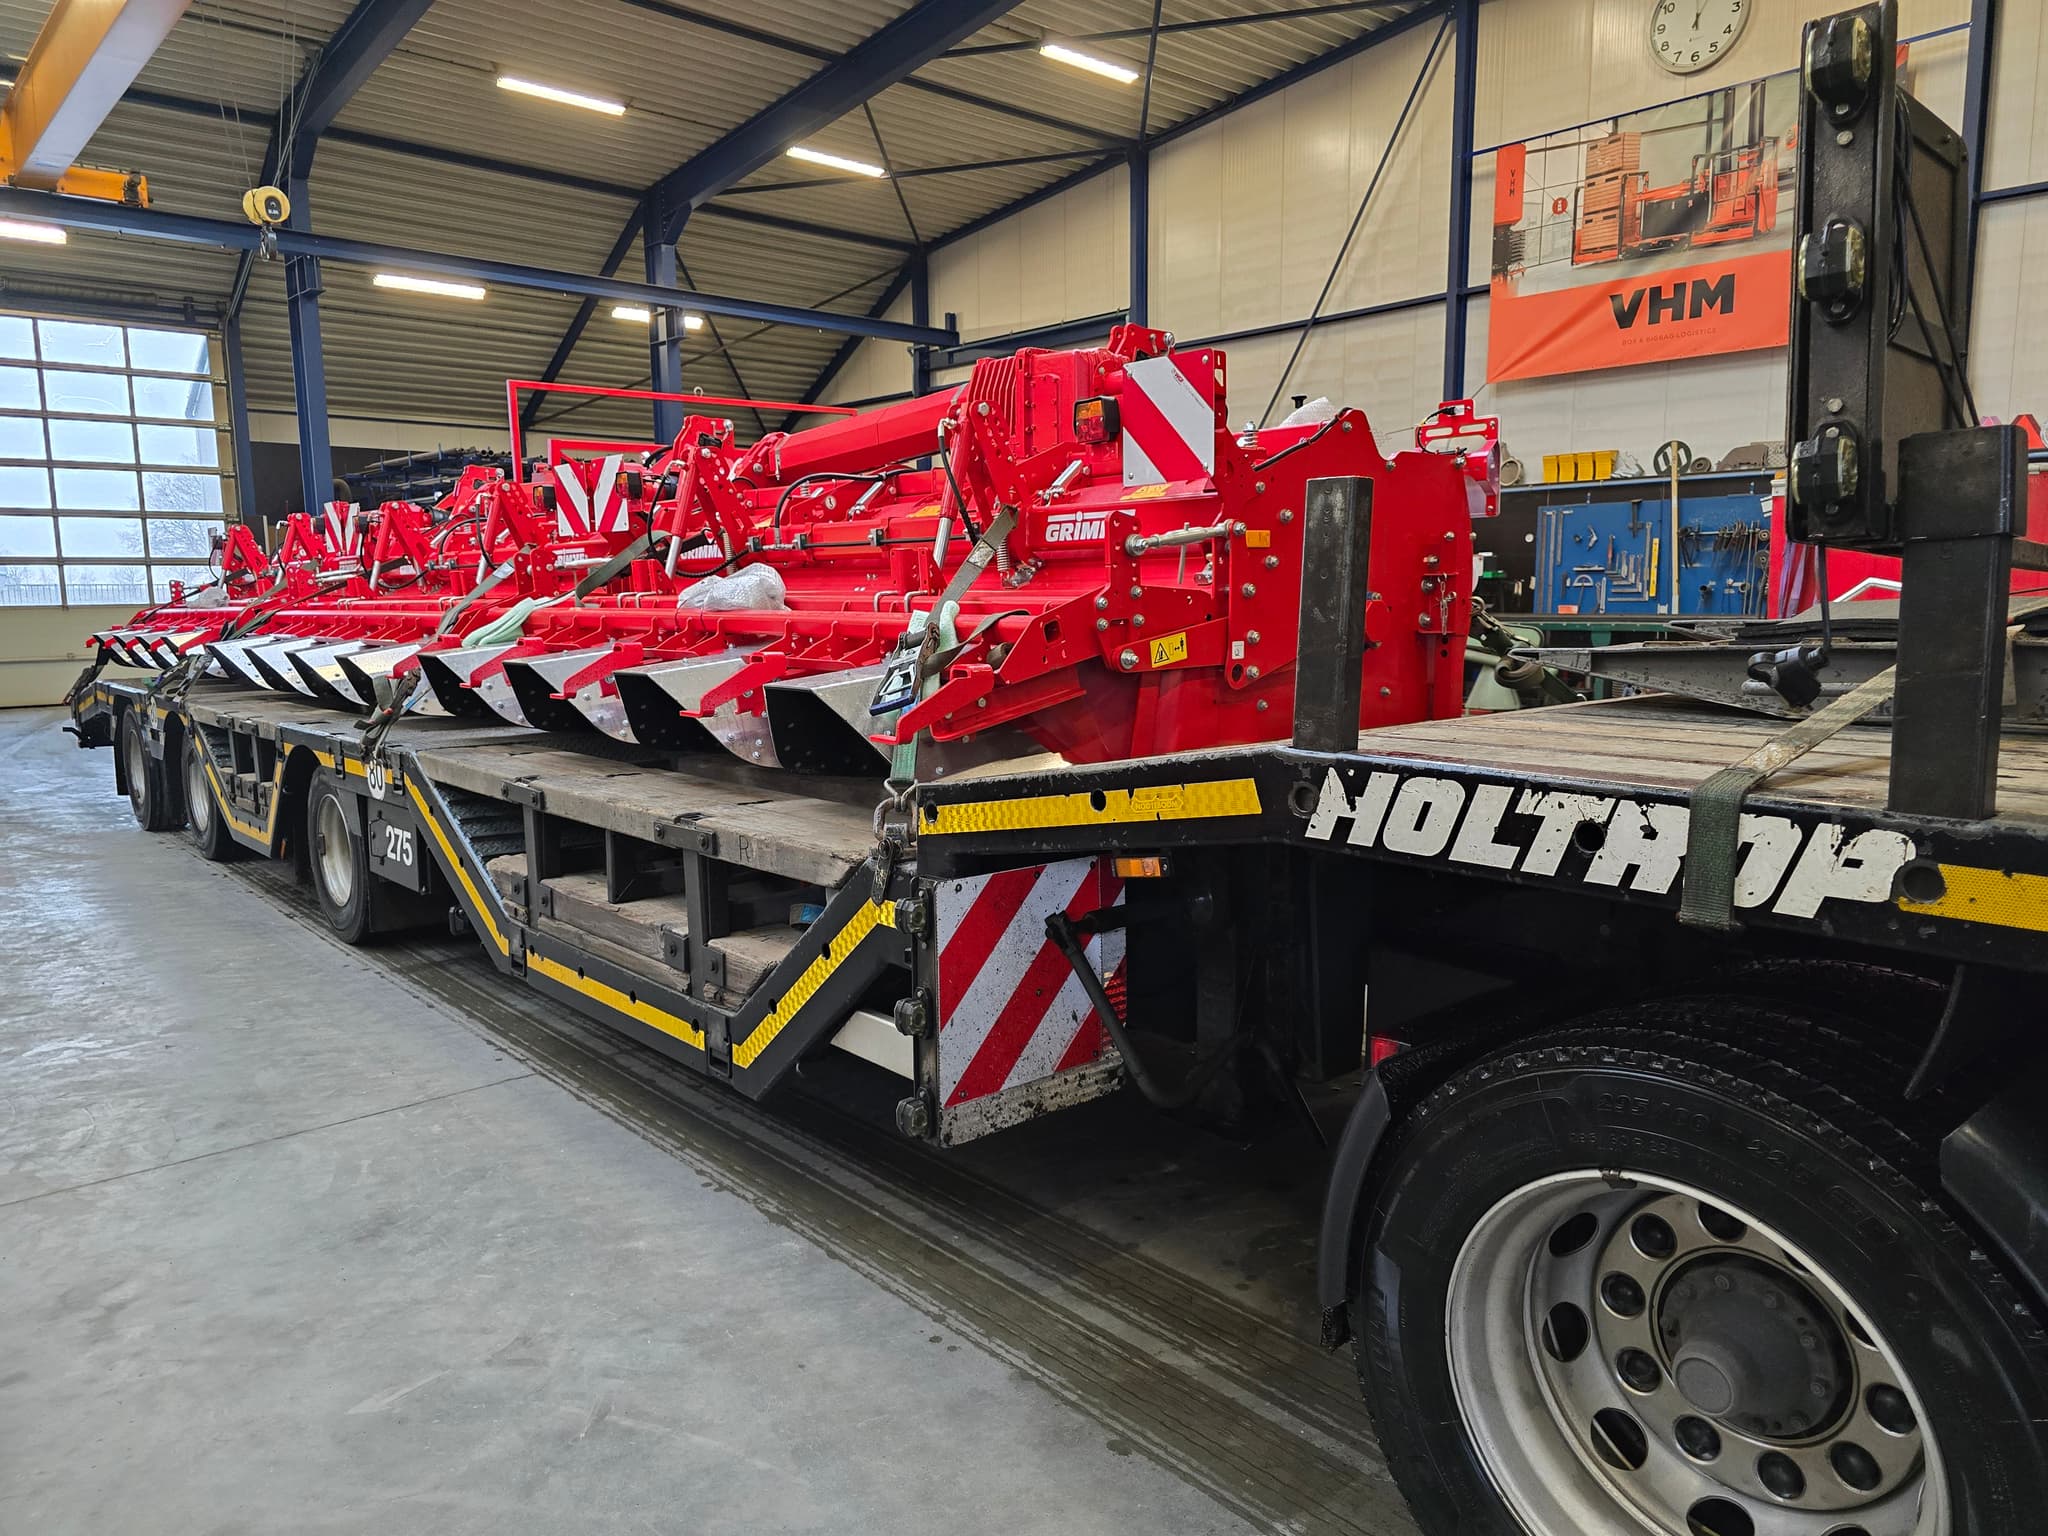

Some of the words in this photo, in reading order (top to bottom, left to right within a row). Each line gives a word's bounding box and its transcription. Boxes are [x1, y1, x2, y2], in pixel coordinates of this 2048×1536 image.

[1663, 2, 1676, 15] 10
[1731, 1, 1741, 13] 3
[1657, 24, 1666, 35] 9
[1723, 24, 1733, 35] 4
[1661, 41, 1670, 52] 8
[1709, 41, 1719, 53] 5
[1673, 51, 1682, 62] 7
[1691, 51, 1700, 62] 6
[1608, 273, 1736, 329] VHM
[1045, 511, 1106, 542] GRIM
[369, 760, 383, 790] 80
[386, 825, 413, 866] 275
[1304, 767, 1917, 918] HOLTROP
